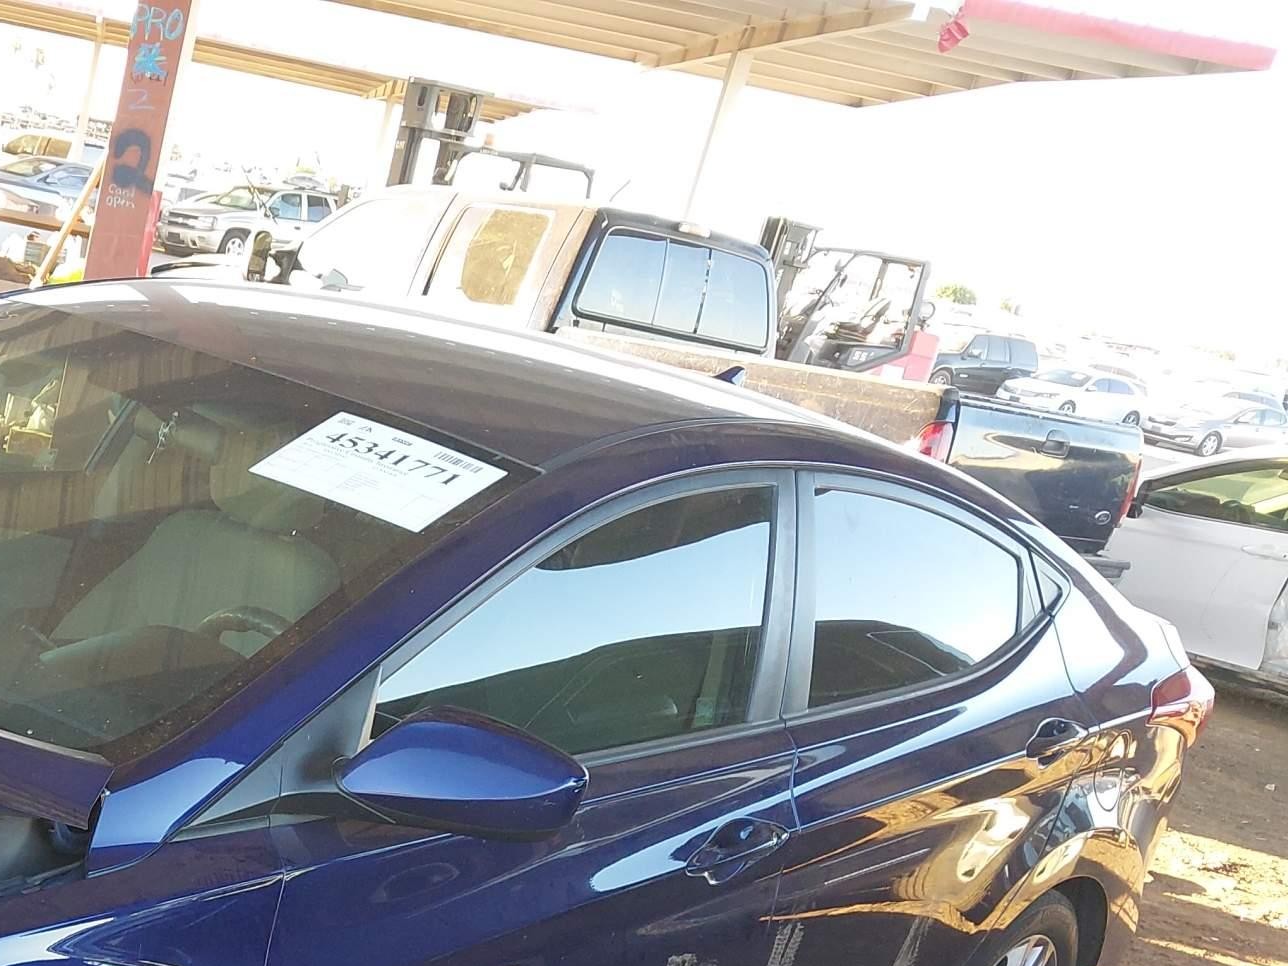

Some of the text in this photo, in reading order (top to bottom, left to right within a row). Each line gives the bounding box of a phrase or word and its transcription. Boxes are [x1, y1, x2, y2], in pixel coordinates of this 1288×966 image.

[130, 3, 184, 41] PRO
[127, 88, 154, 110] 2
[112, 128, 154, 196] 2
[326, 432, 463, 486] 45341771
